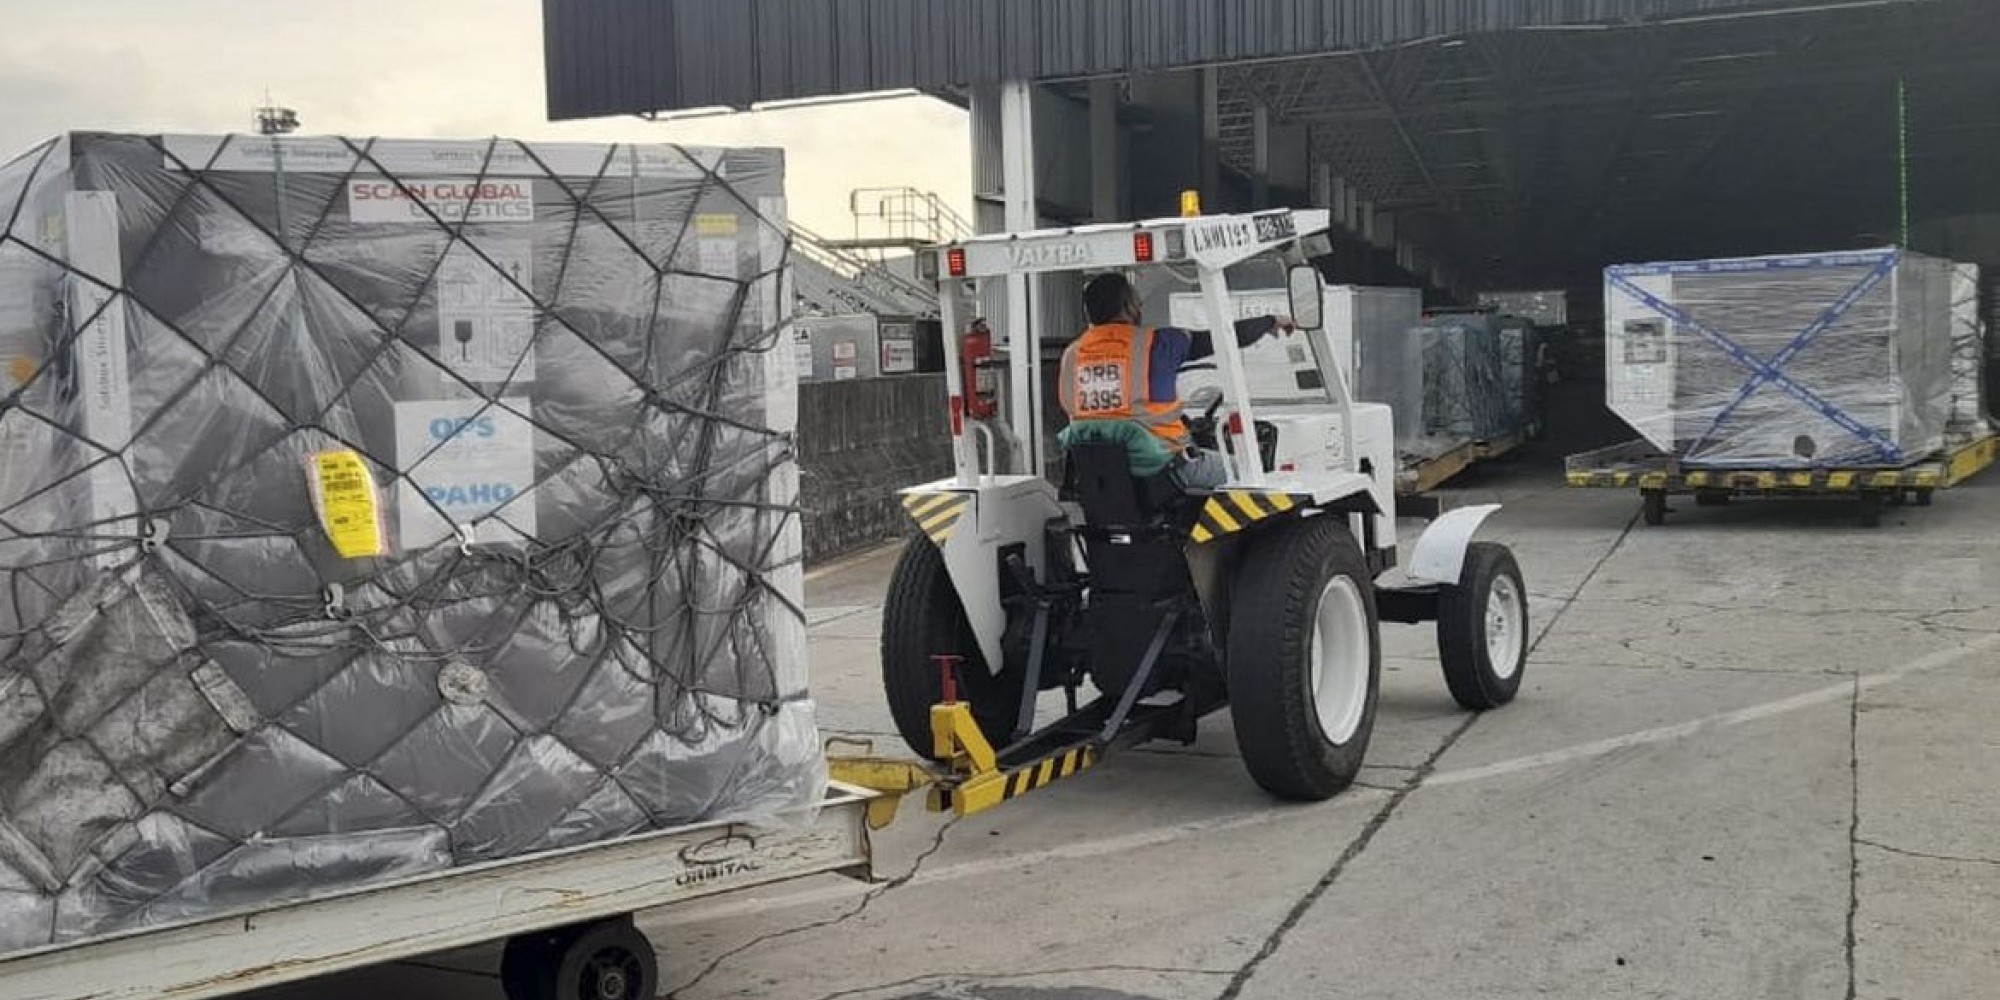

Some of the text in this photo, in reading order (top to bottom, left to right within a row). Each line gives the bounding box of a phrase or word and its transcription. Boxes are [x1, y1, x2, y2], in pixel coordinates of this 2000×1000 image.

[353, 183, 529, 201] SCAN GLOBAL
[410, 202, 531, 218] LOGISTICS
[1007, 242, 1089, 267] VALTRA
[429, 415, 496, 439] OPS
[424, 482, 515, 505] PAHO
